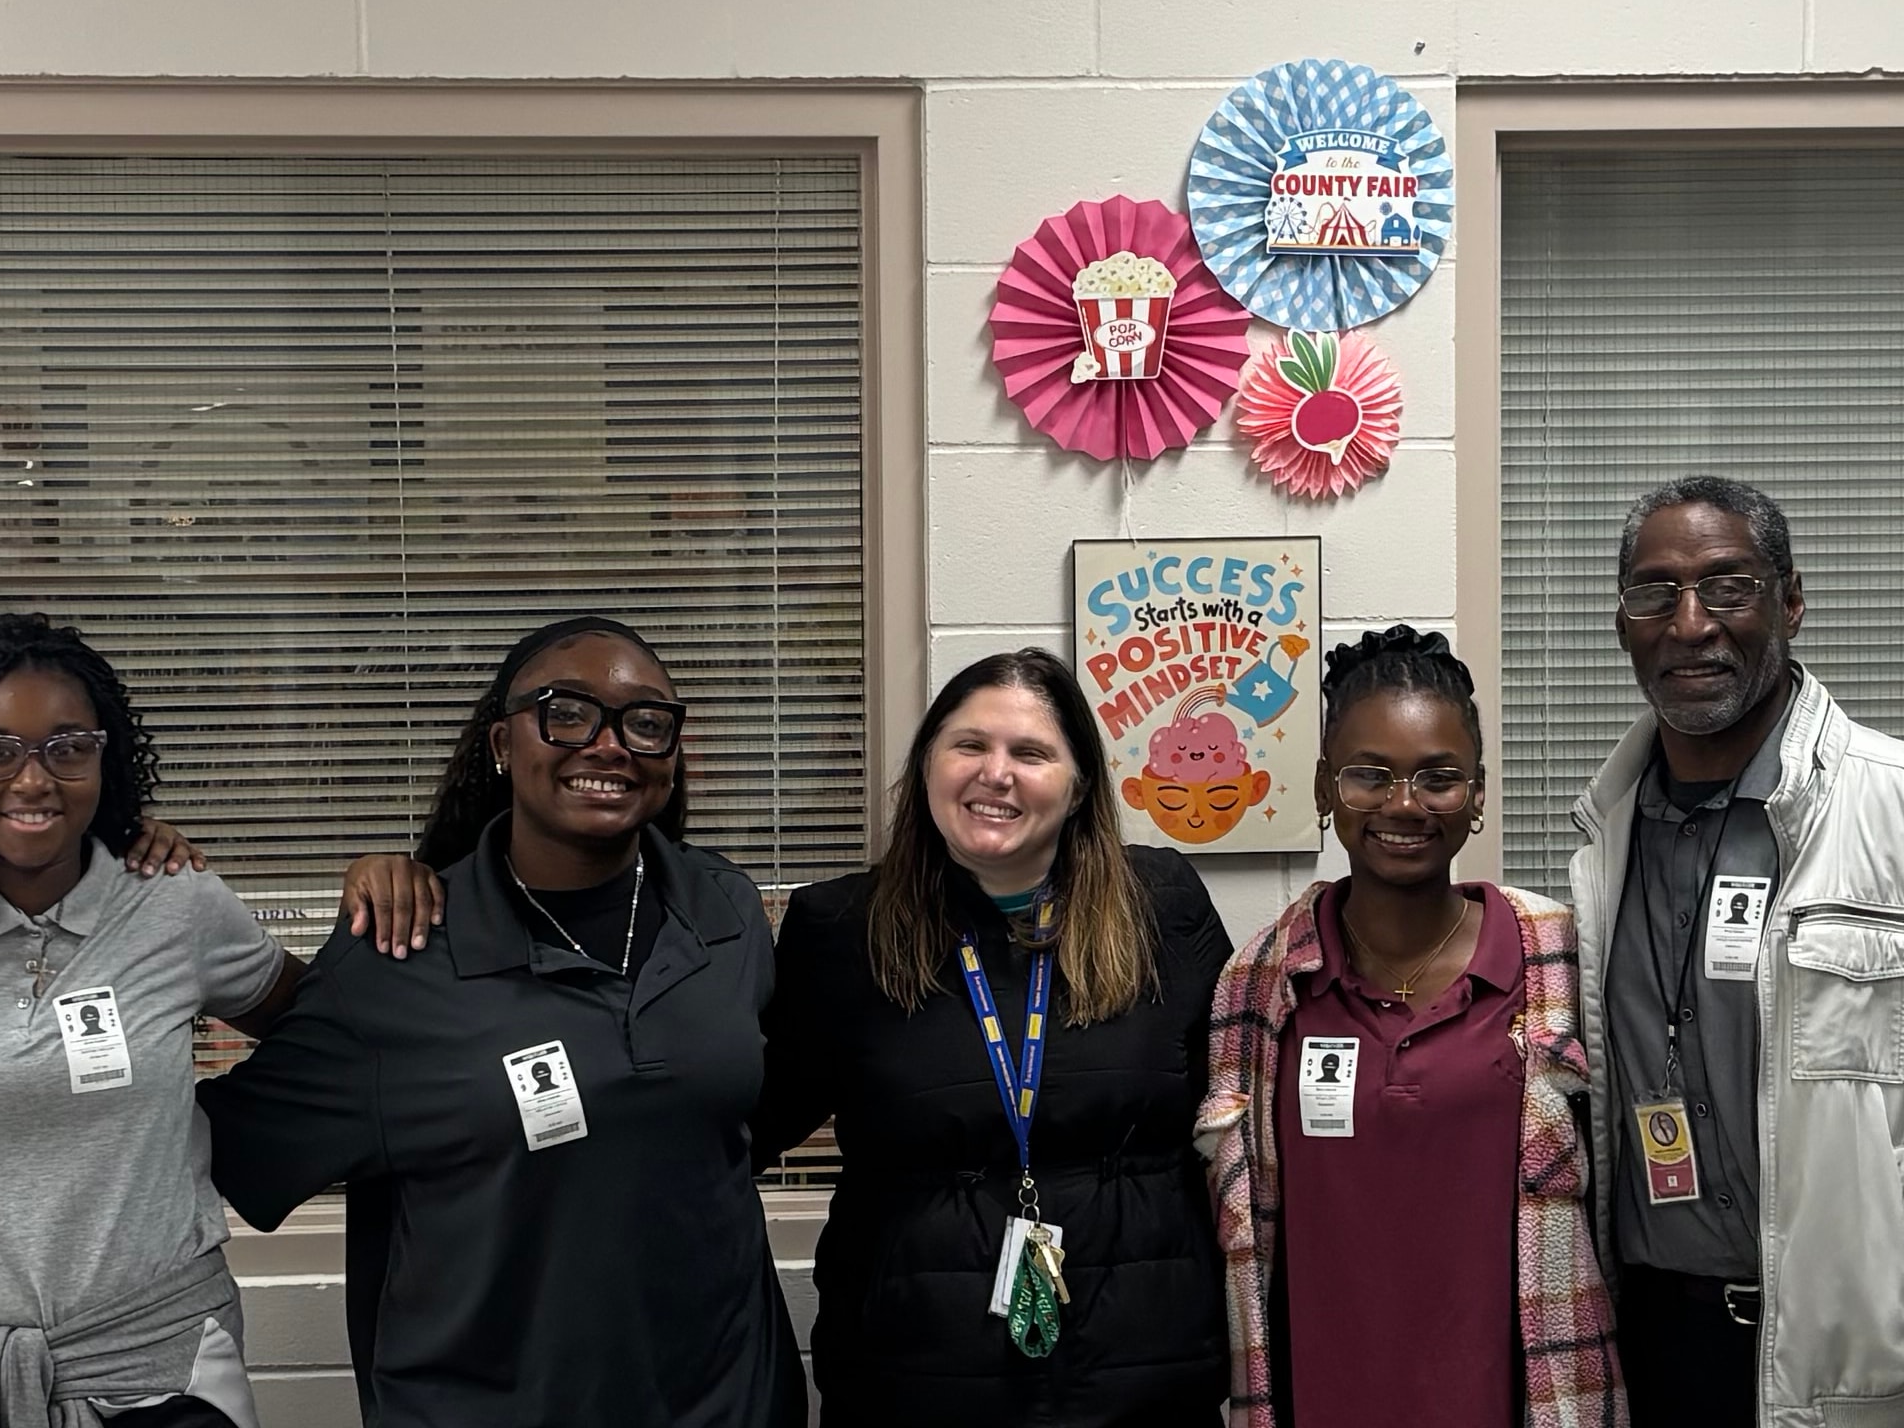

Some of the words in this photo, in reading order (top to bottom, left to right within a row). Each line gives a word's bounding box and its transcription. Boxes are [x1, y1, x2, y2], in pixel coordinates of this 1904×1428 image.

[1296, 133, 1390, 154] WELCOME
[1326, 157, 1337, 168] to
[1341, 157, 1360, 168] the
[1273, 174, 1362, 197] COUNTY
[1367, 176, 1417, 197] FAIR
[1108, 331, 1142, 348] CORN
[1109, 323, 1137, 335] POP
[1087, 556, 1305, 636] SUCCESS
[1202, 598, 1243, 624] with
[1247, 611, 1263, 627] a
[1086, 622, 1268, 693] POSITIVE
[1097, 656, 1242, 740] MINDSET
